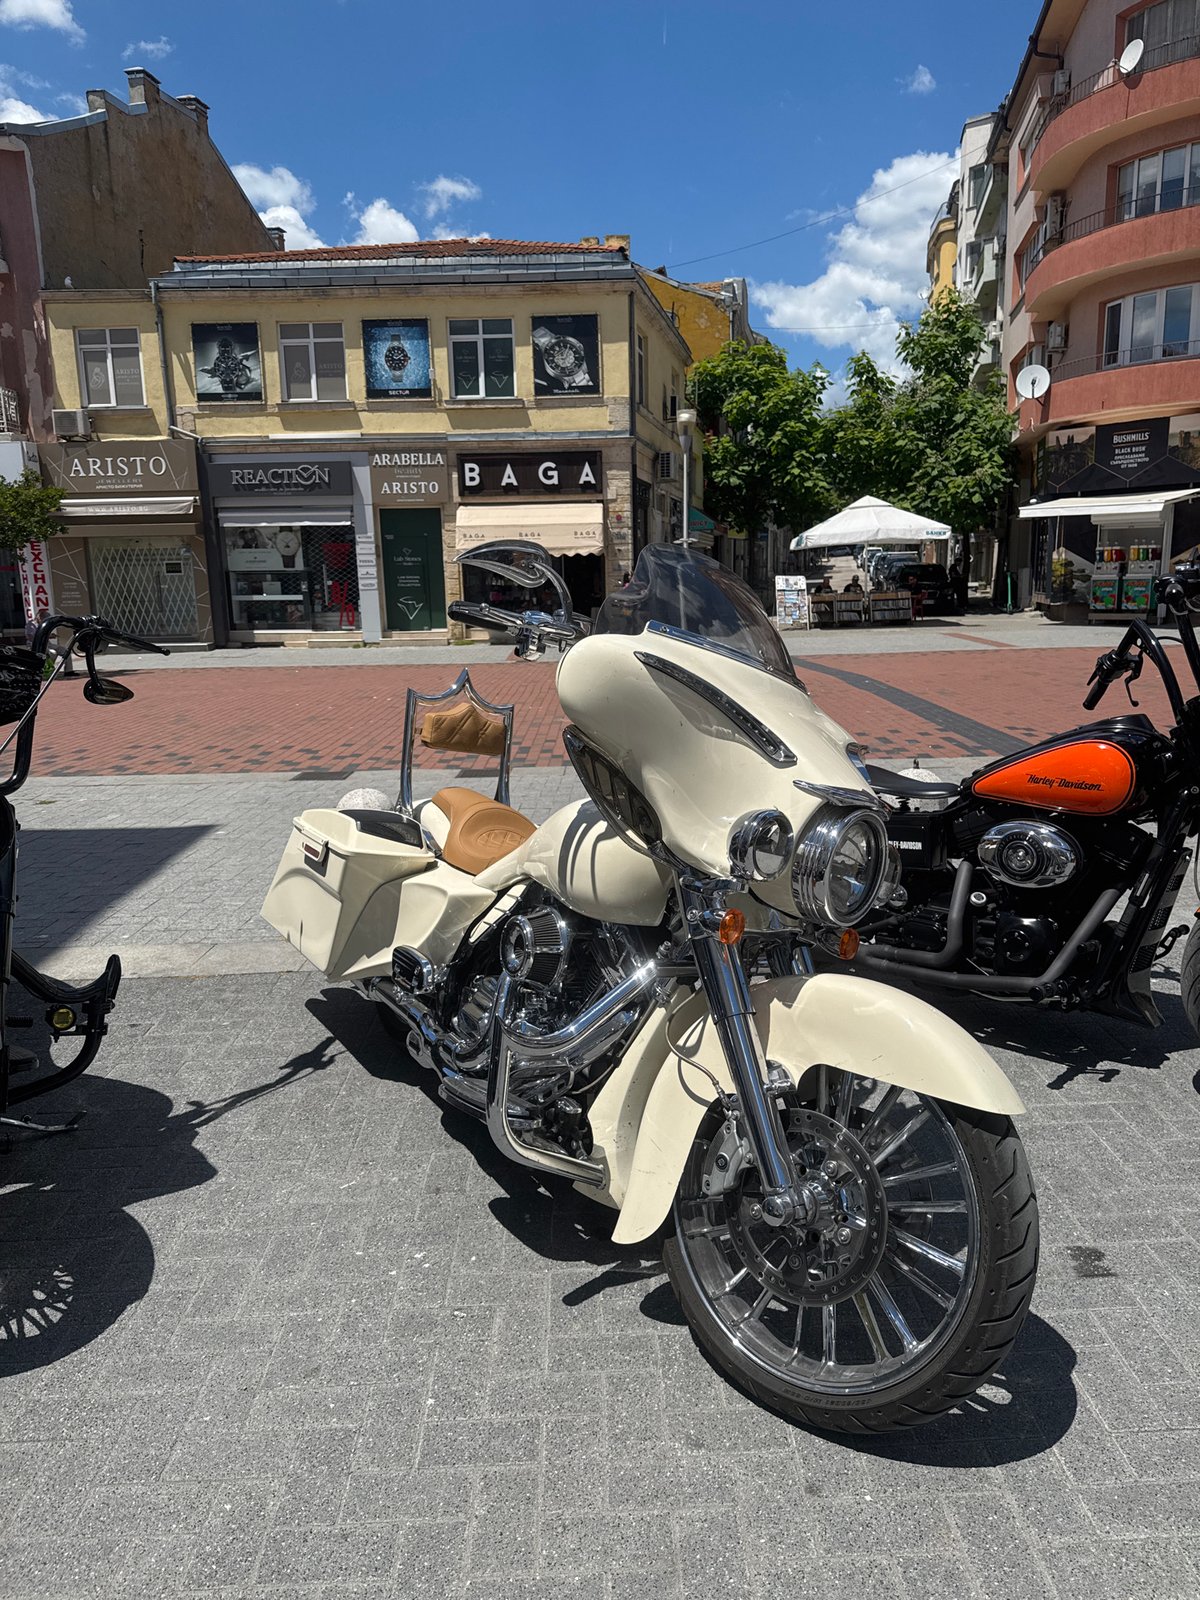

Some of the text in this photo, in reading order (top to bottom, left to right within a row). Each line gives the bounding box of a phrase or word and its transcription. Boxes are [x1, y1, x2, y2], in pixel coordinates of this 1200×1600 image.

[1113, 432, 1150, 444] BUSHMILLS
[70, 456, 167, 477] ARISTO
[372, 453, 444, 466] ARABELLA
[230, 464, 330, 485] REACTION
[464, 461, 596, 487] BAGA
[381, 481, 439, 494] ARISTO
[30, 540, 49, 612] EXCHAN
[1025, 773, 1104, 791] Harley-Davidson
